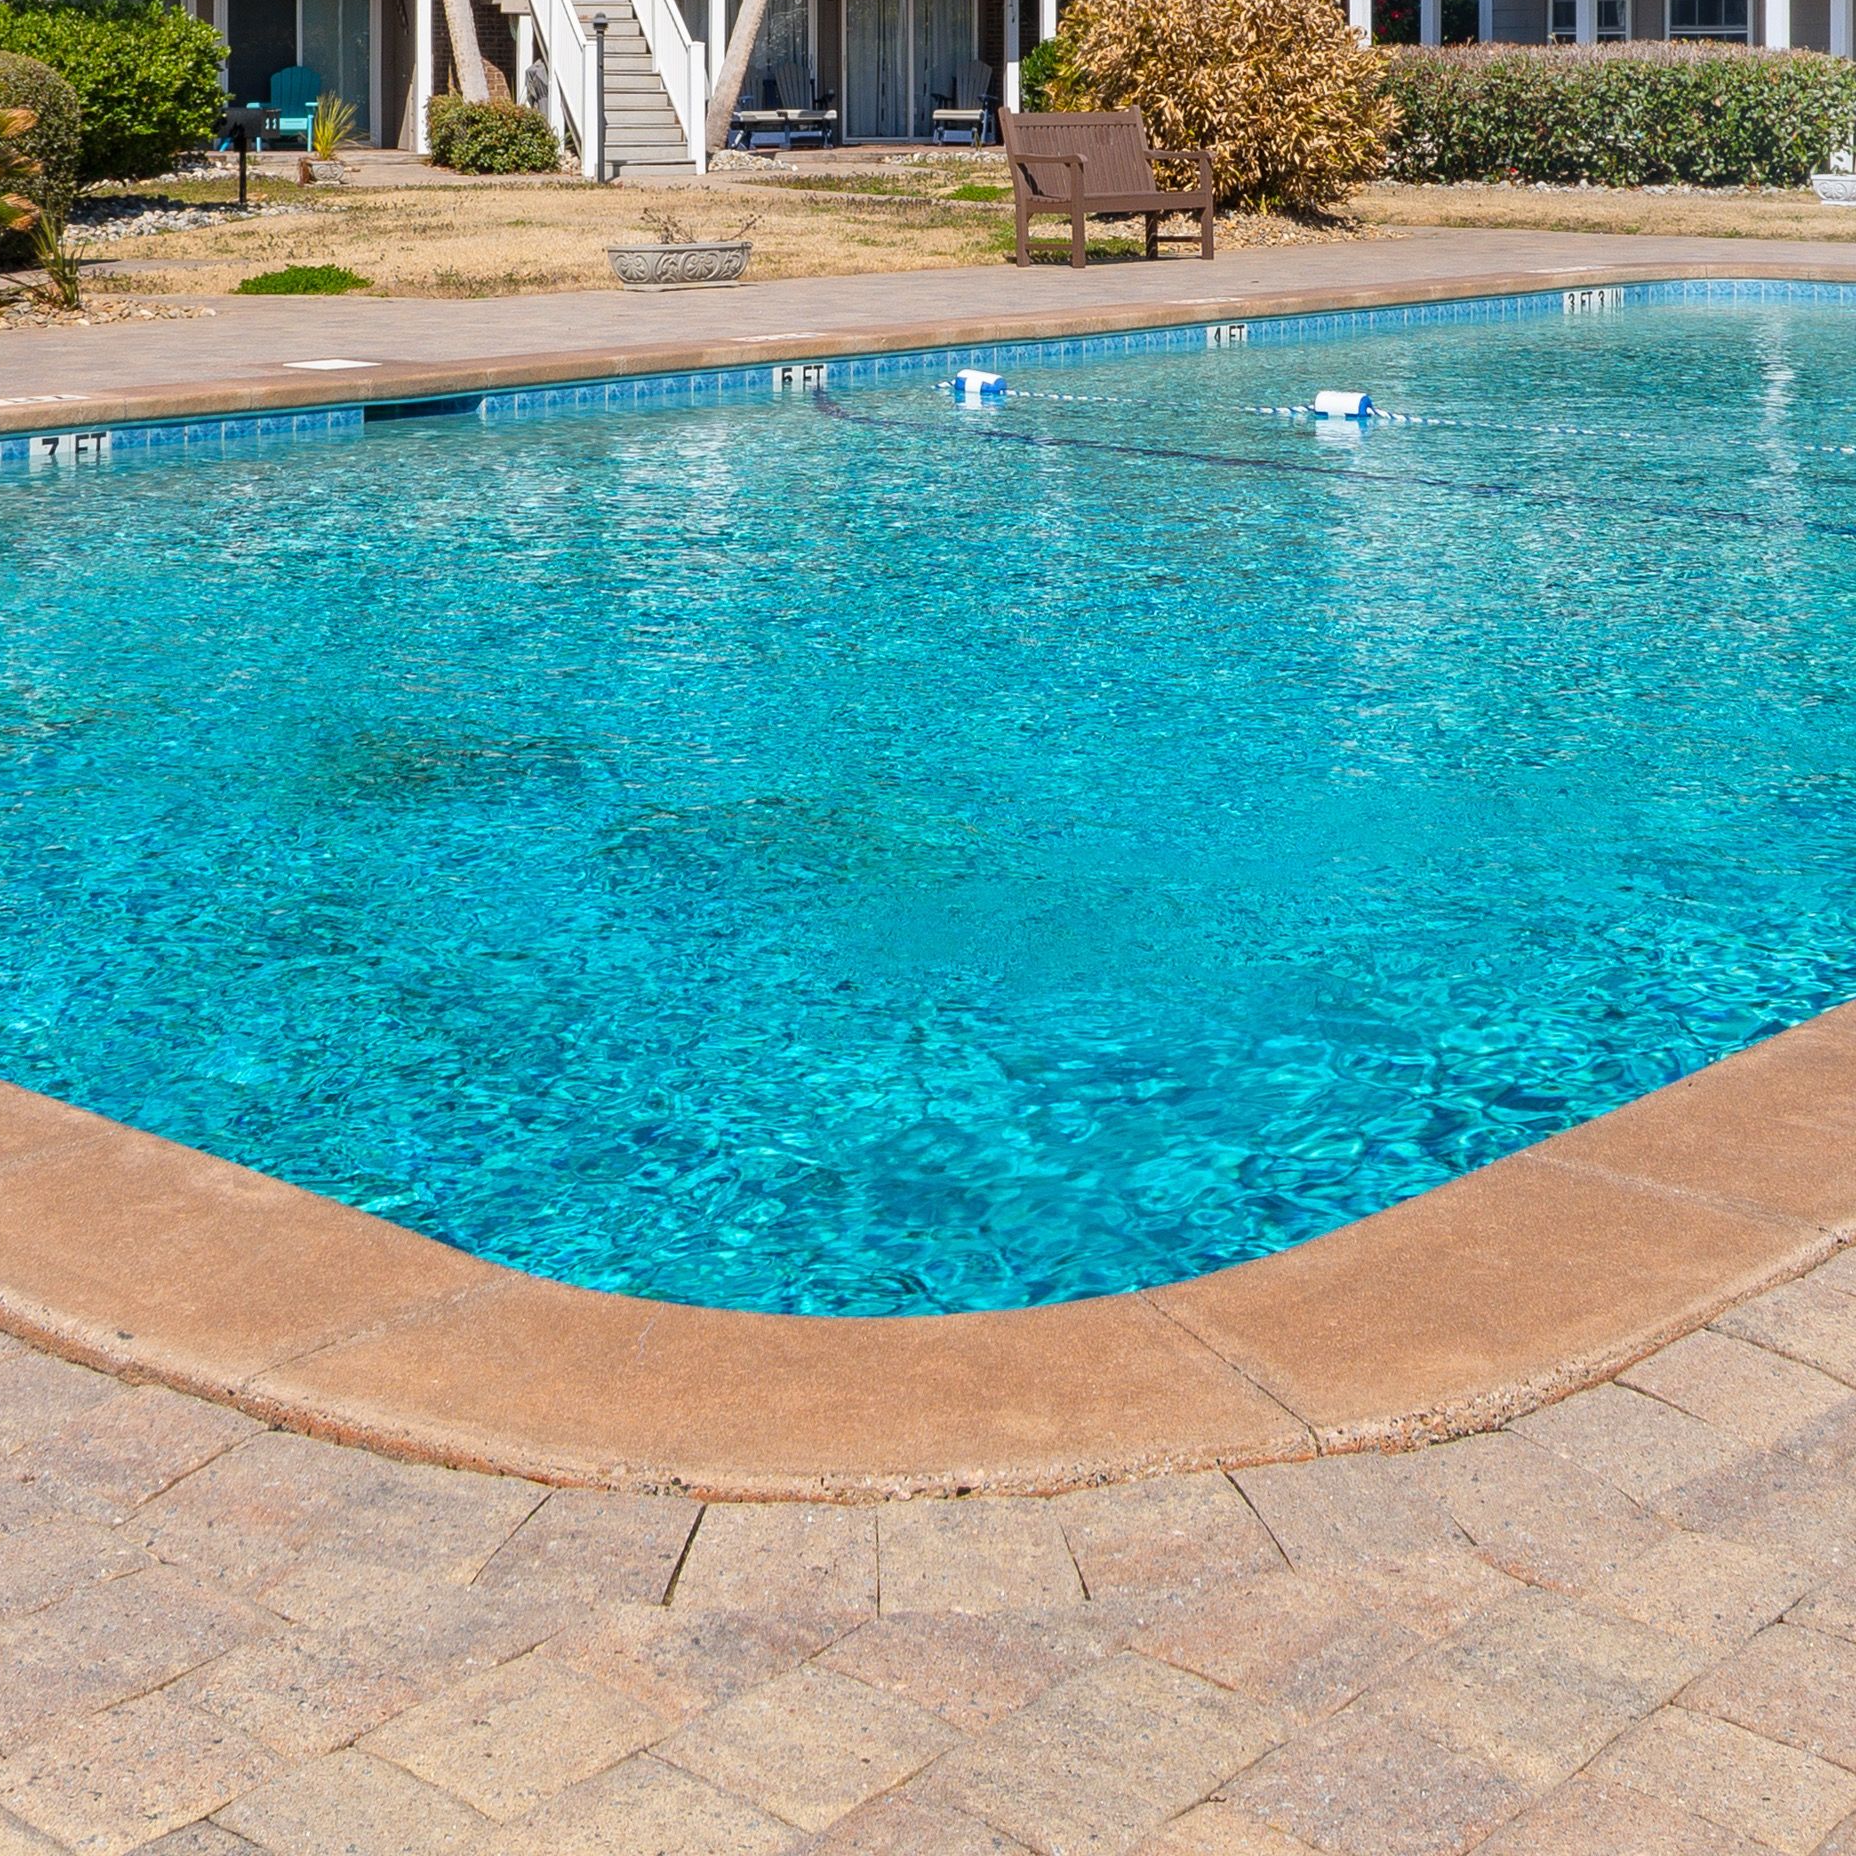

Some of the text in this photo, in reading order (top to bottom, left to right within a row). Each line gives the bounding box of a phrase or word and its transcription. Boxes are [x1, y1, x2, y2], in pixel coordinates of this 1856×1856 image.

[1568, 293, 1575, 306] 3
[1581, 291, 1593, 310] FT
[1610, 289, 1621, 311] IN
[1229, 325, 1245, 342] FT
[803, 364, 824, 384] FT
[42, 433, 107, 455] 7 FT
